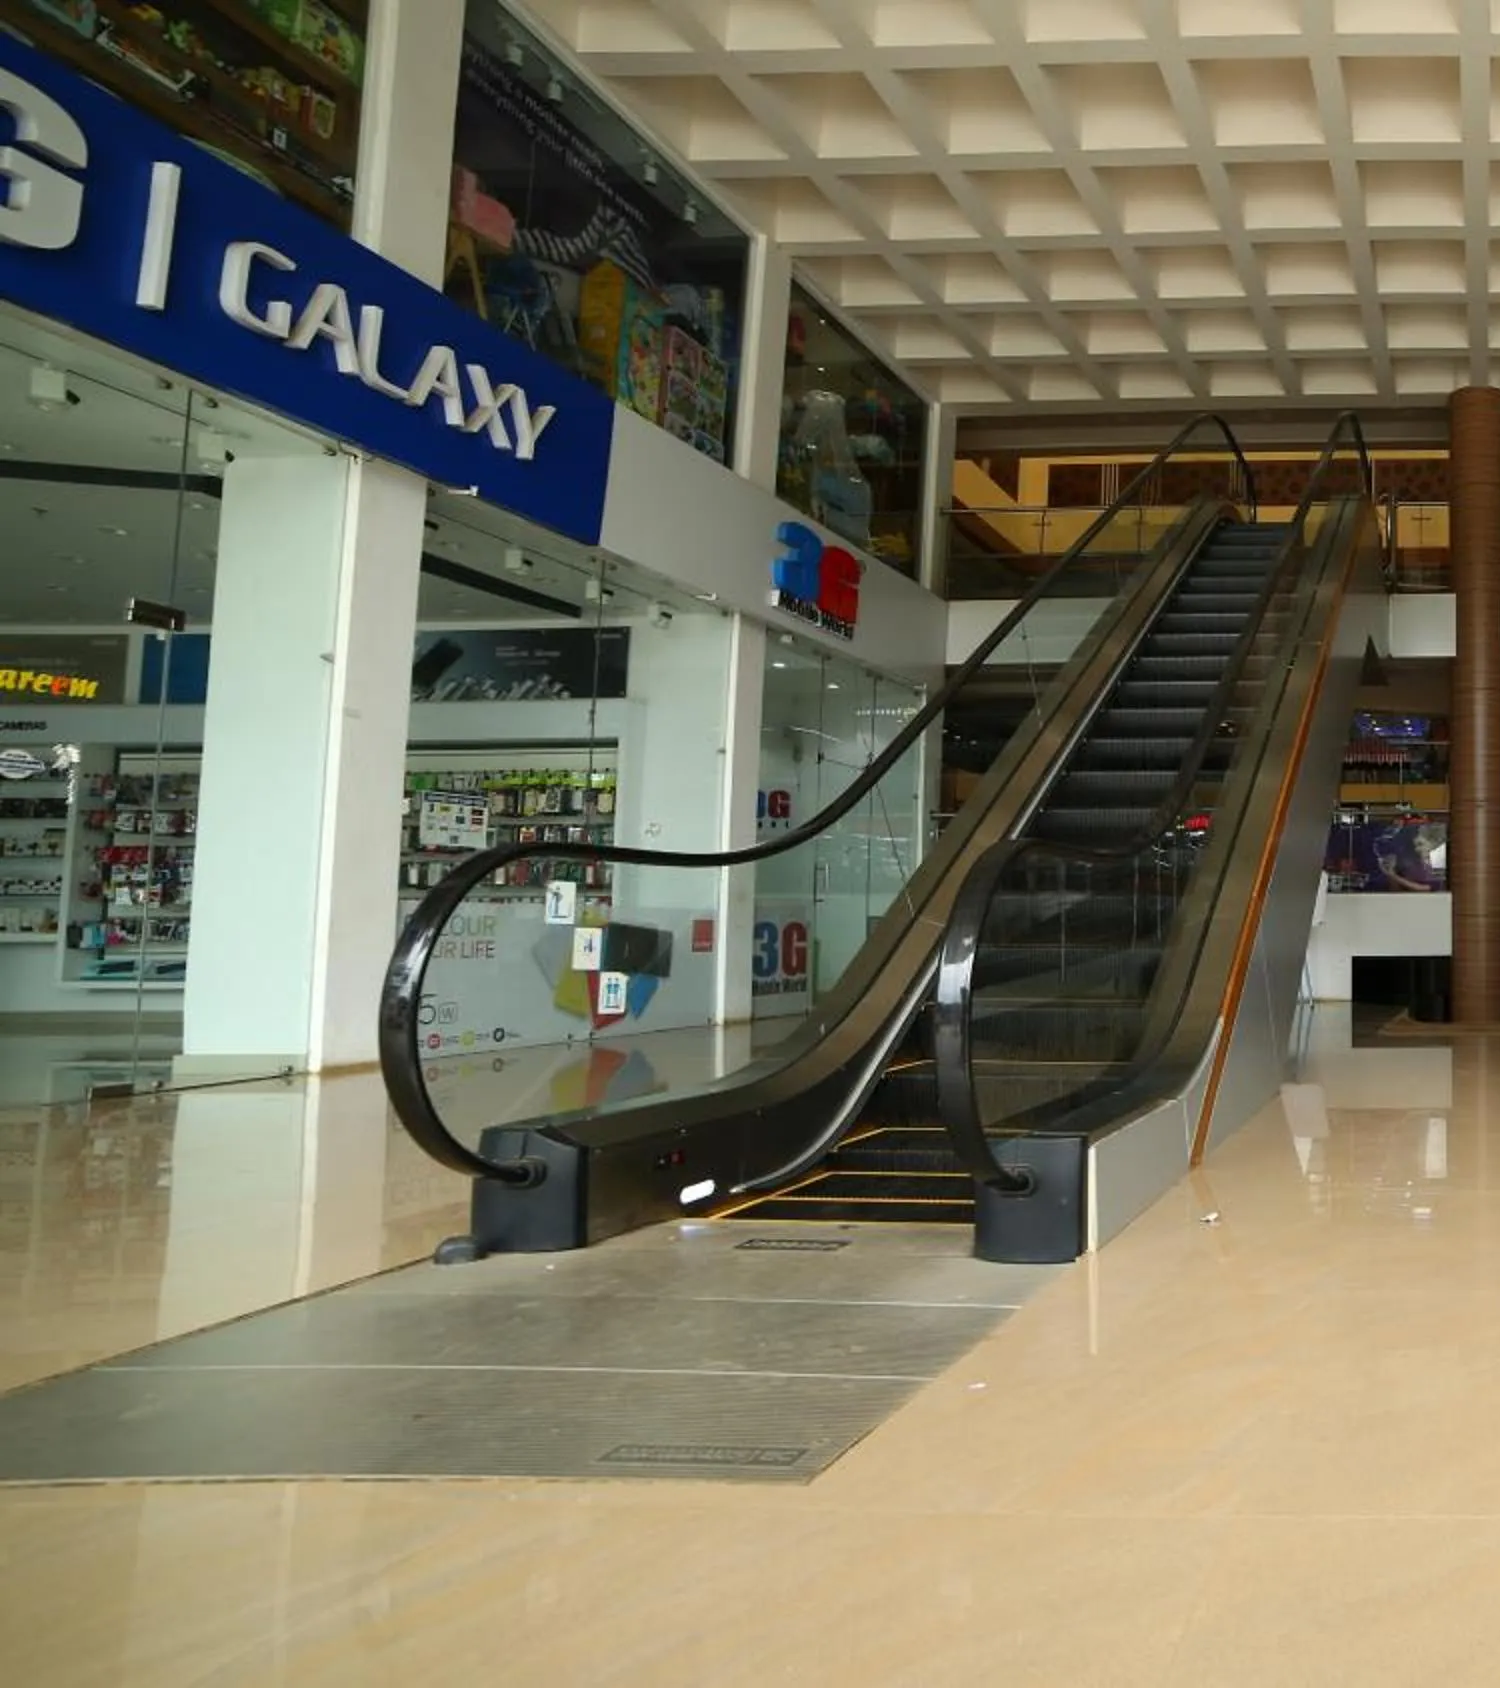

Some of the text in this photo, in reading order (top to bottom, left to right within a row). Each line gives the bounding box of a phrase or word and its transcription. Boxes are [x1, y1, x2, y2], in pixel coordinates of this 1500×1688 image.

[219, 241, 556, 459] GALAXY
[772, 521, 861, 626] 3G
[461, 940, 496, 959] LIFE
[752, 921, 808, 977] 3G
